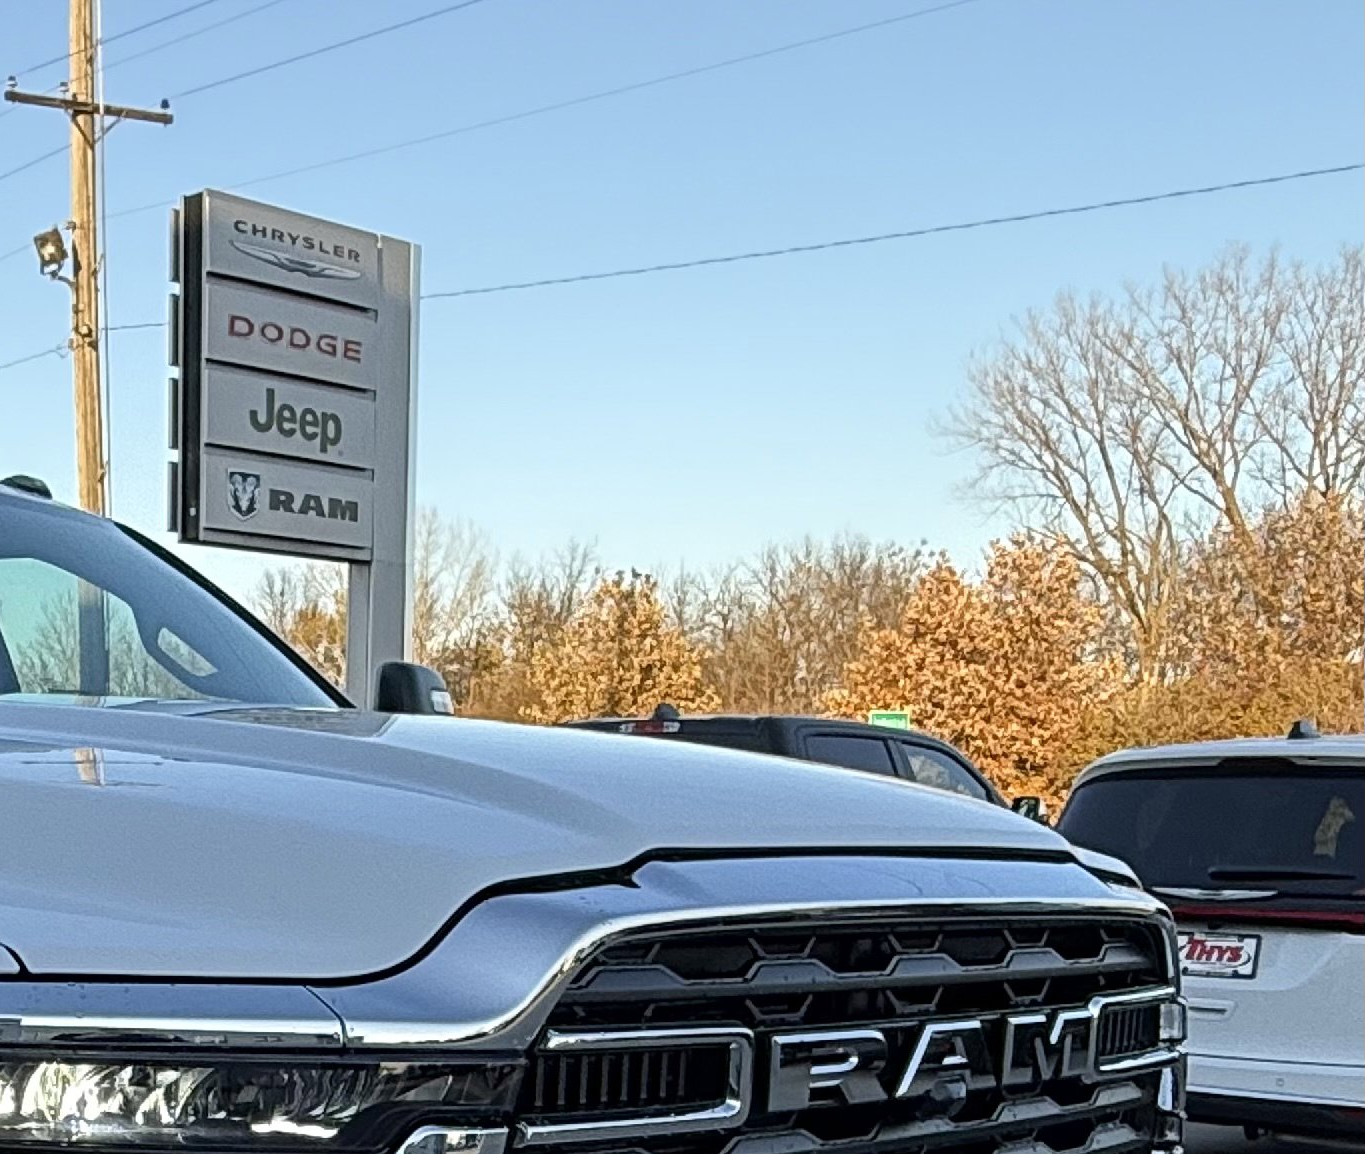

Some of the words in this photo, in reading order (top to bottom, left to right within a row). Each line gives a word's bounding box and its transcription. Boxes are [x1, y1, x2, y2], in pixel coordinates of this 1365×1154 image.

[233, 219, 361, 263] CHRYSLER
[228, 313, 363, 363] DODGE
[249, 387, 342, 454] Jeep
[268, 489, 359, 523] RAM
[1185, 936, 1244, 963] THYS
[768, 1012, 1096, 1113] RAM
